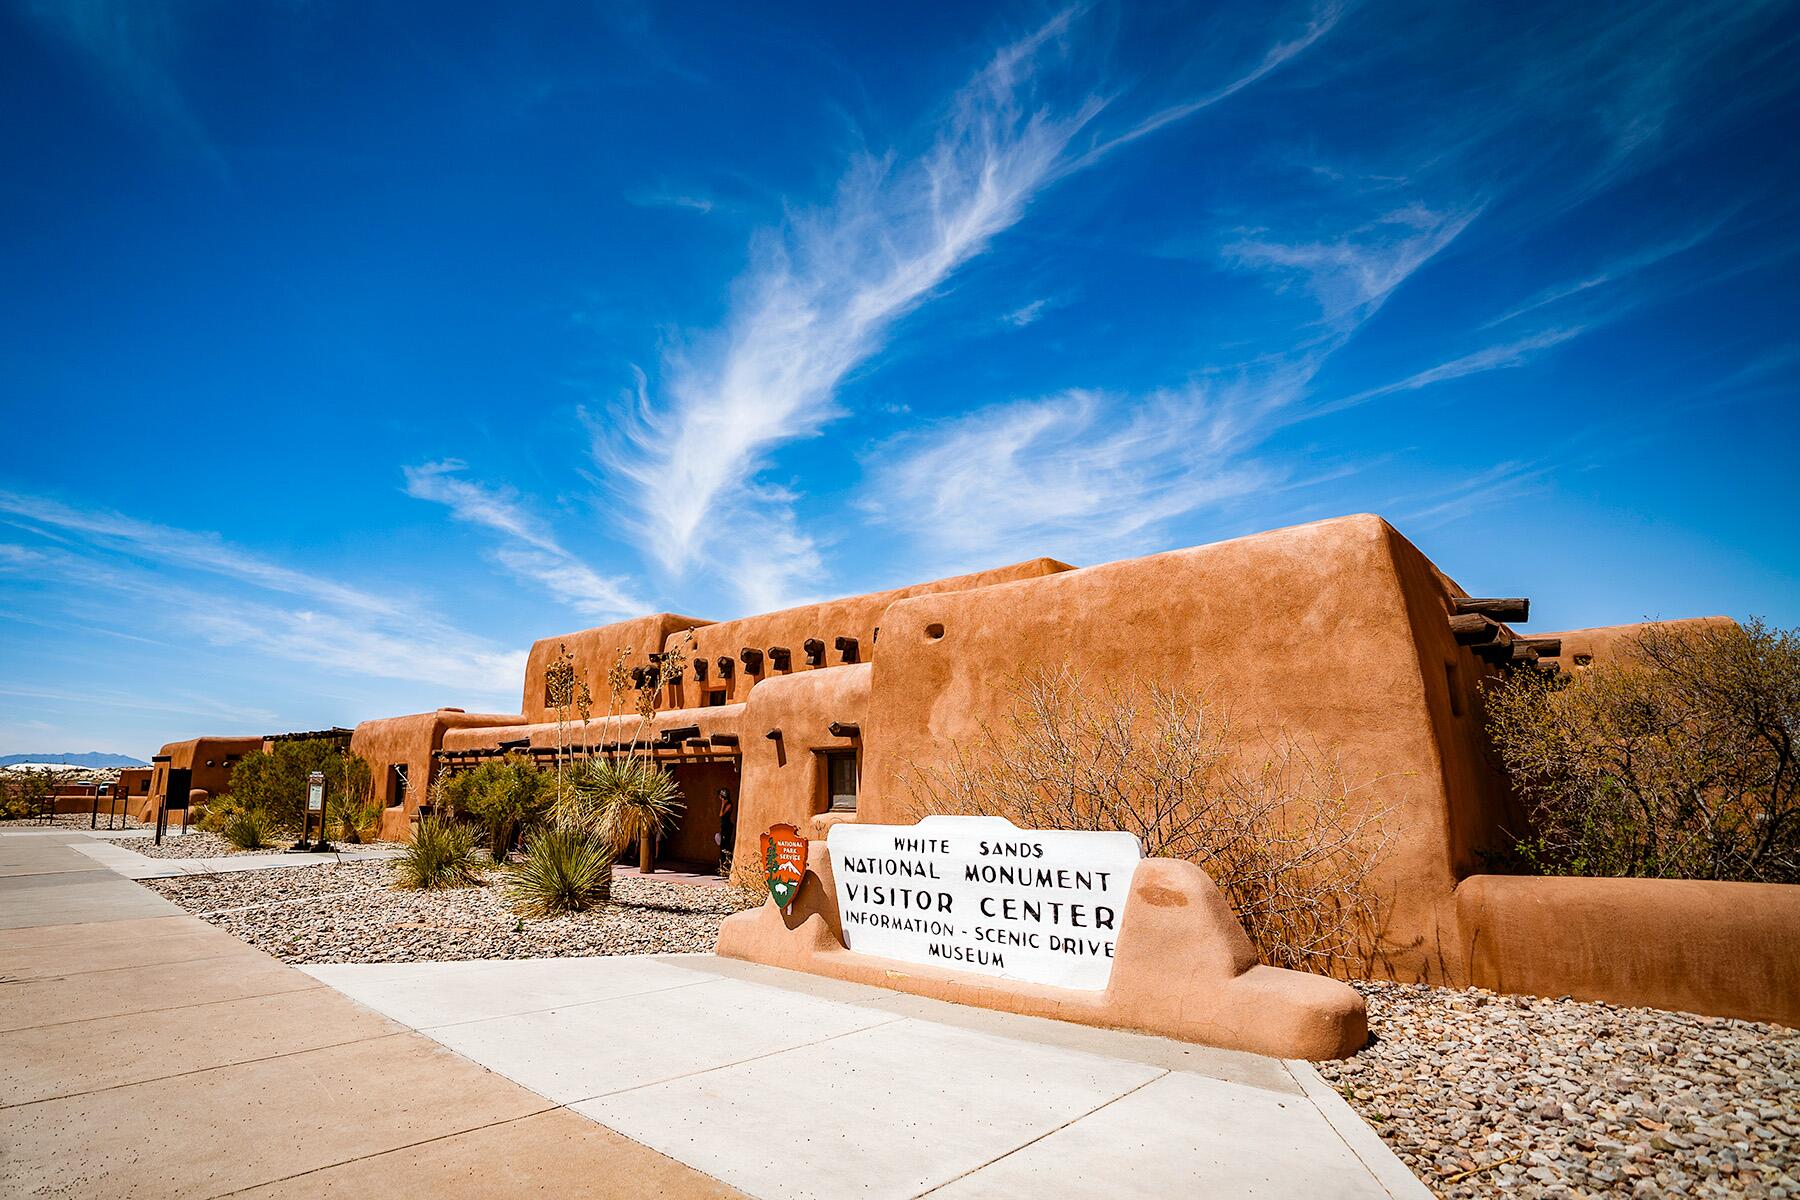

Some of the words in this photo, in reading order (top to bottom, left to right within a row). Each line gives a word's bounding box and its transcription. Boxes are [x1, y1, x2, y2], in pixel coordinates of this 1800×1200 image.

[895, 837, 949, 853] WHITE
[980, 841, 1043, 858] SANDS
[845, 856, 940, 879] NATIONAL
[965, 865, 1110, 891] MONUMENT
[846, 883, 952, 913] VISITOR
[981, 898, 1114, 930] CENTER
[846, 911, 953, 936] INFORMATION
[975, 927, 1039, 948] SCENIC
[1050, 936, 1114, 958] DRIVE
[929, 944, 1003, 968] MUSEUM
